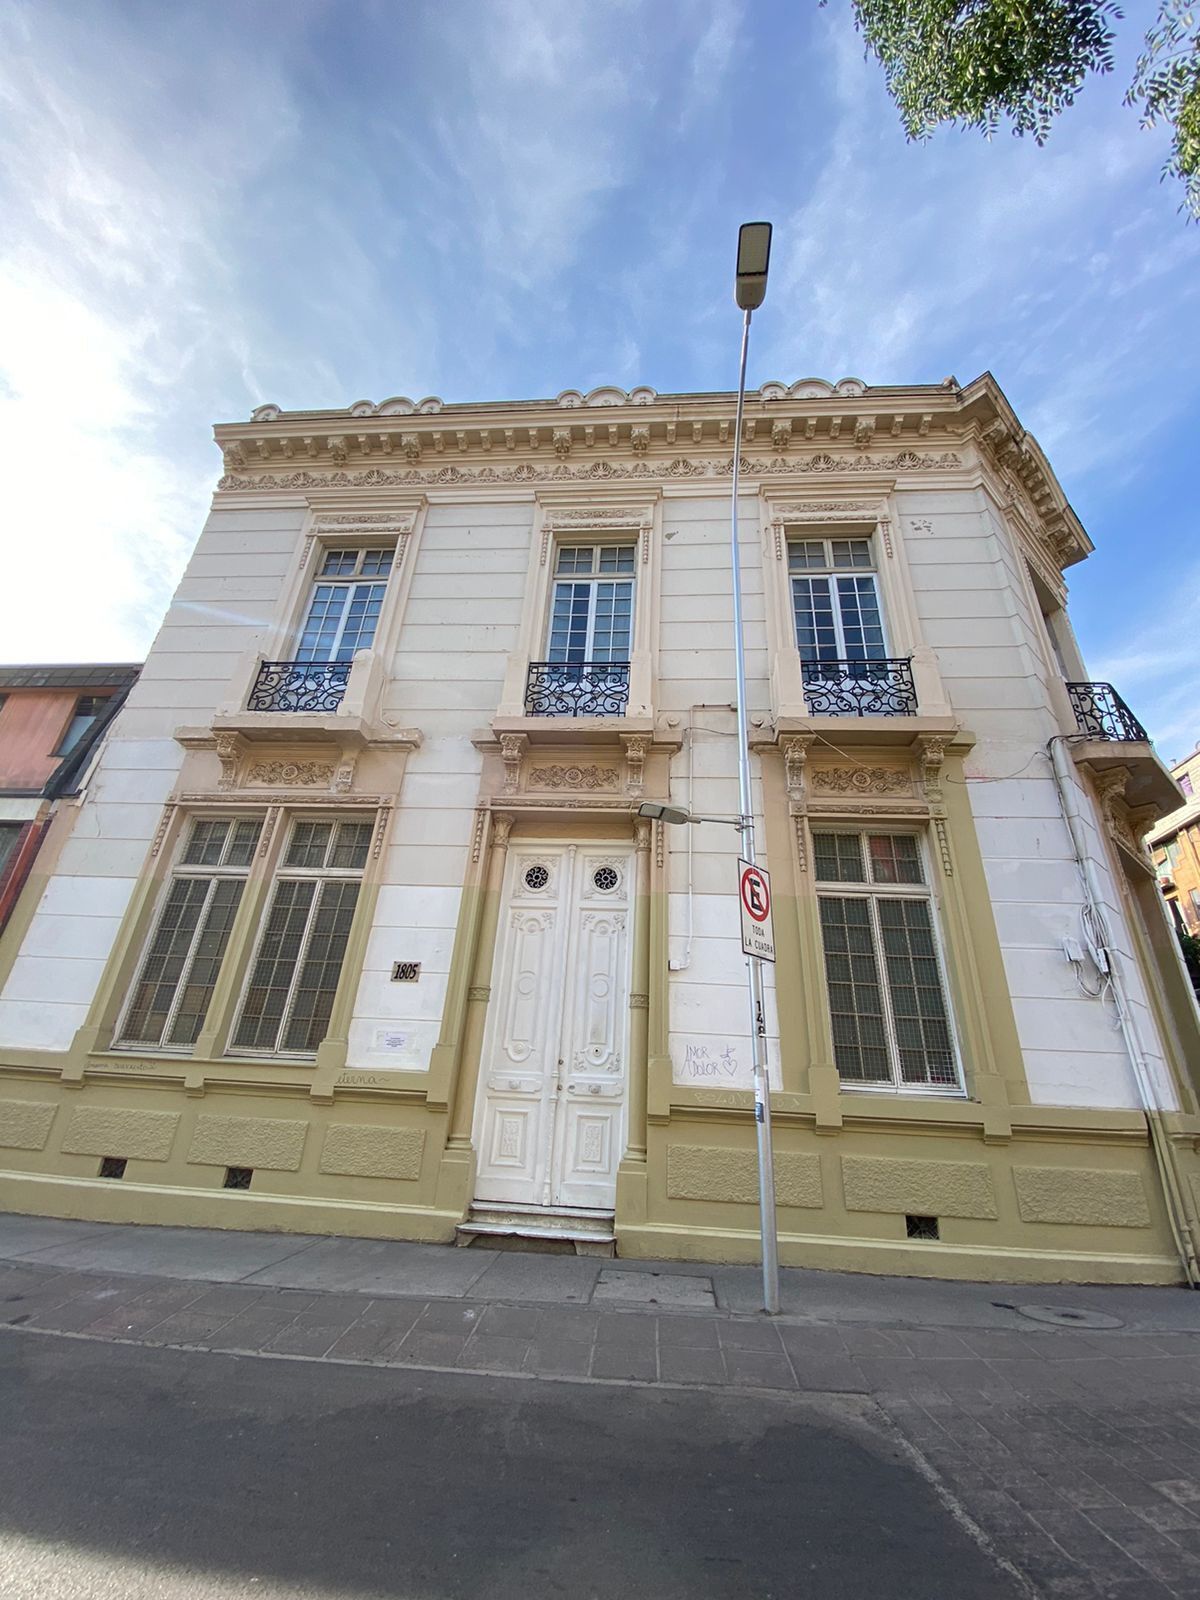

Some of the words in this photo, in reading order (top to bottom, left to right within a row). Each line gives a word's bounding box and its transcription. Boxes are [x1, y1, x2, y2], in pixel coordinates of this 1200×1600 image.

[750, 878, 764, 912] E
[752, 924, 765, 938] TODA
[744, 935, 753, 948] LA
[754, 939, 773, 953] CUADRA
[394, 963, 418, 980] 1805
